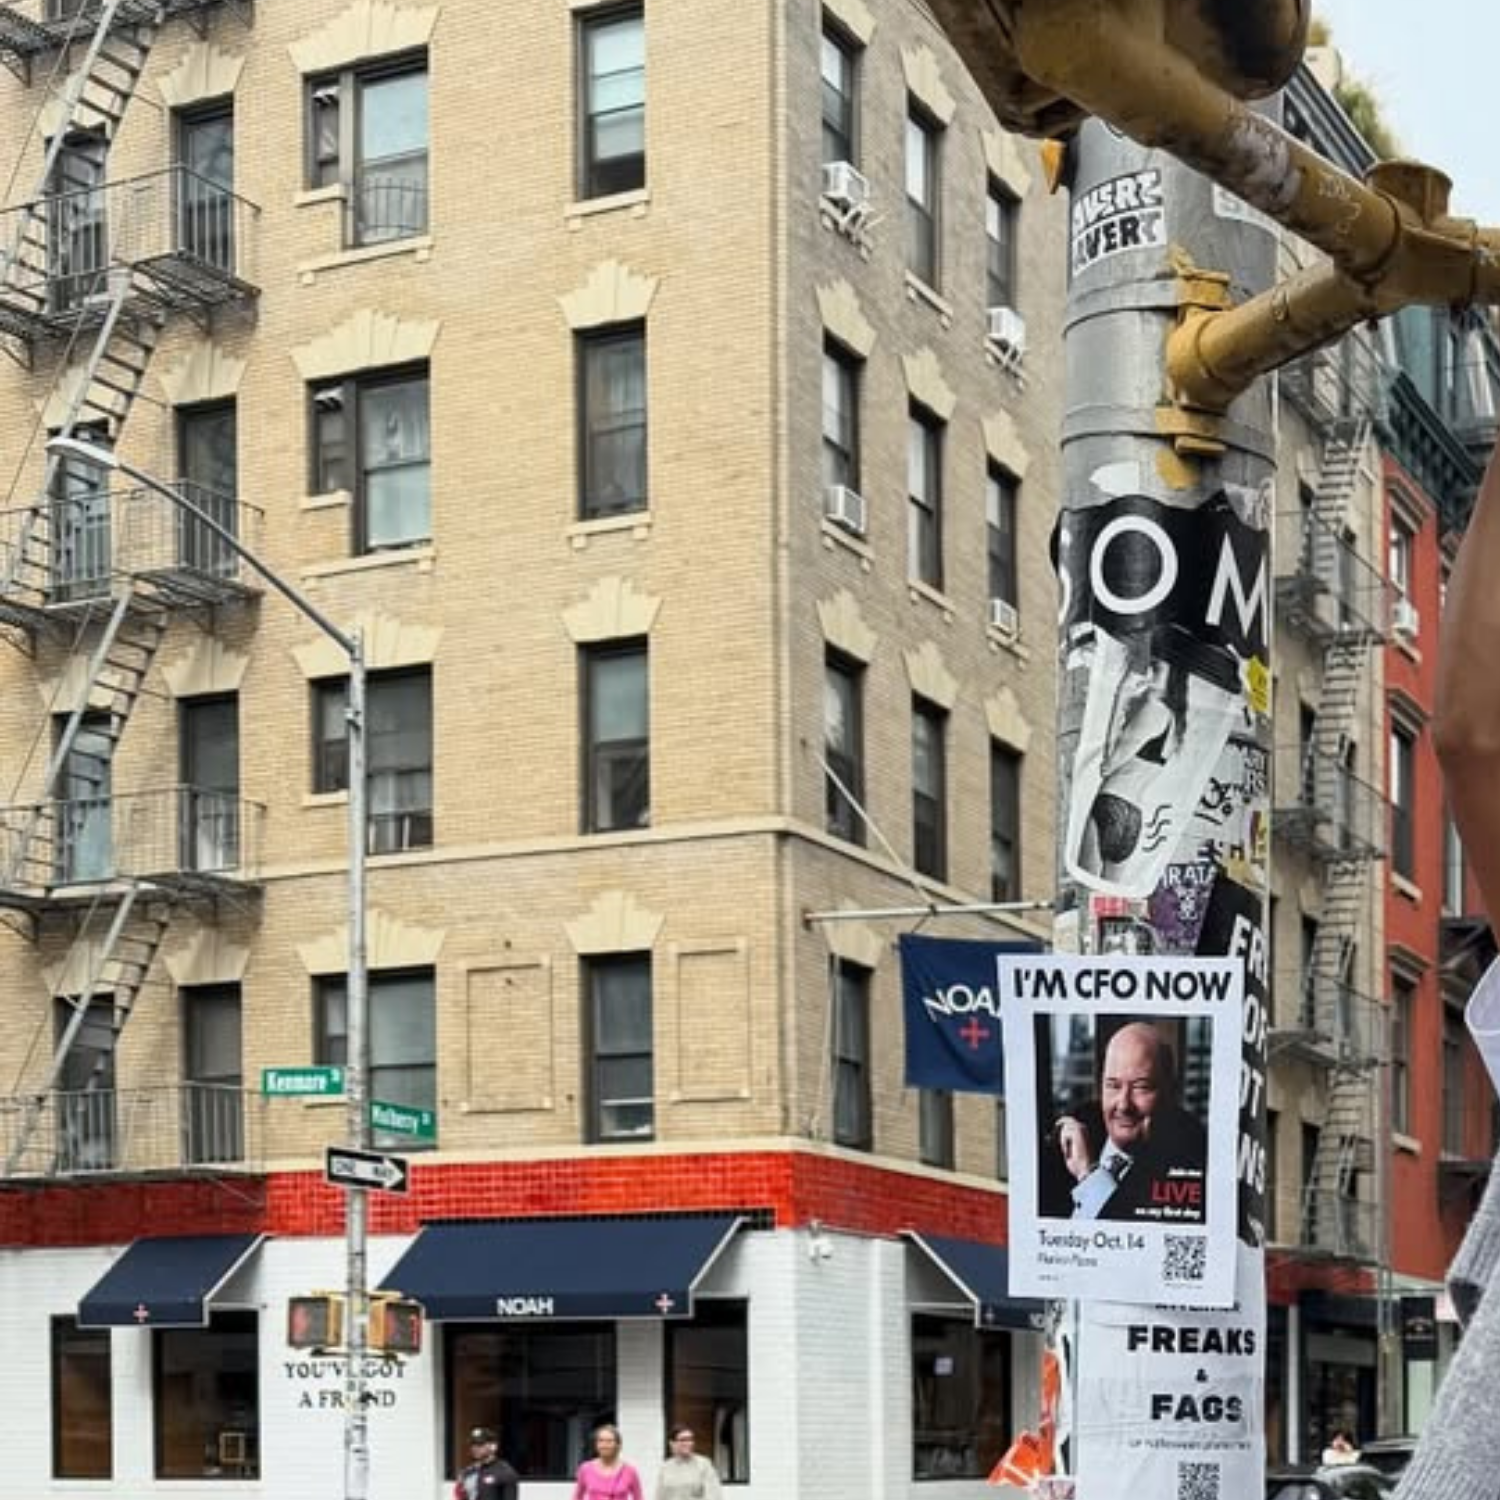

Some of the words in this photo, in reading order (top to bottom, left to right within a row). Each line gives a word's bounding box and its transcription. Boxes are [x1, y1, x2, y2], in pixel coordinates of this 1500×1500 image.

[1013, 968, 1067, 999] I'M
[1074, 969, 1137, 999] CFO
[1146, 971, 1232, 1001] NOW
[922, 983, 1001, 1023] NOA
[1152, 1180, 1201, 1203] LIVE
[1037, 1230, 1089, 1252] Tuesday
[1127, 1233, 1145, 1250] 14
[496, 1297, 554, 1316] NOAH
[1127, 1325, 1256, 1357] FREAKS
[299, 1390, 313, 1409] A
[1151, 1393, 1243, 1423] FAGS
